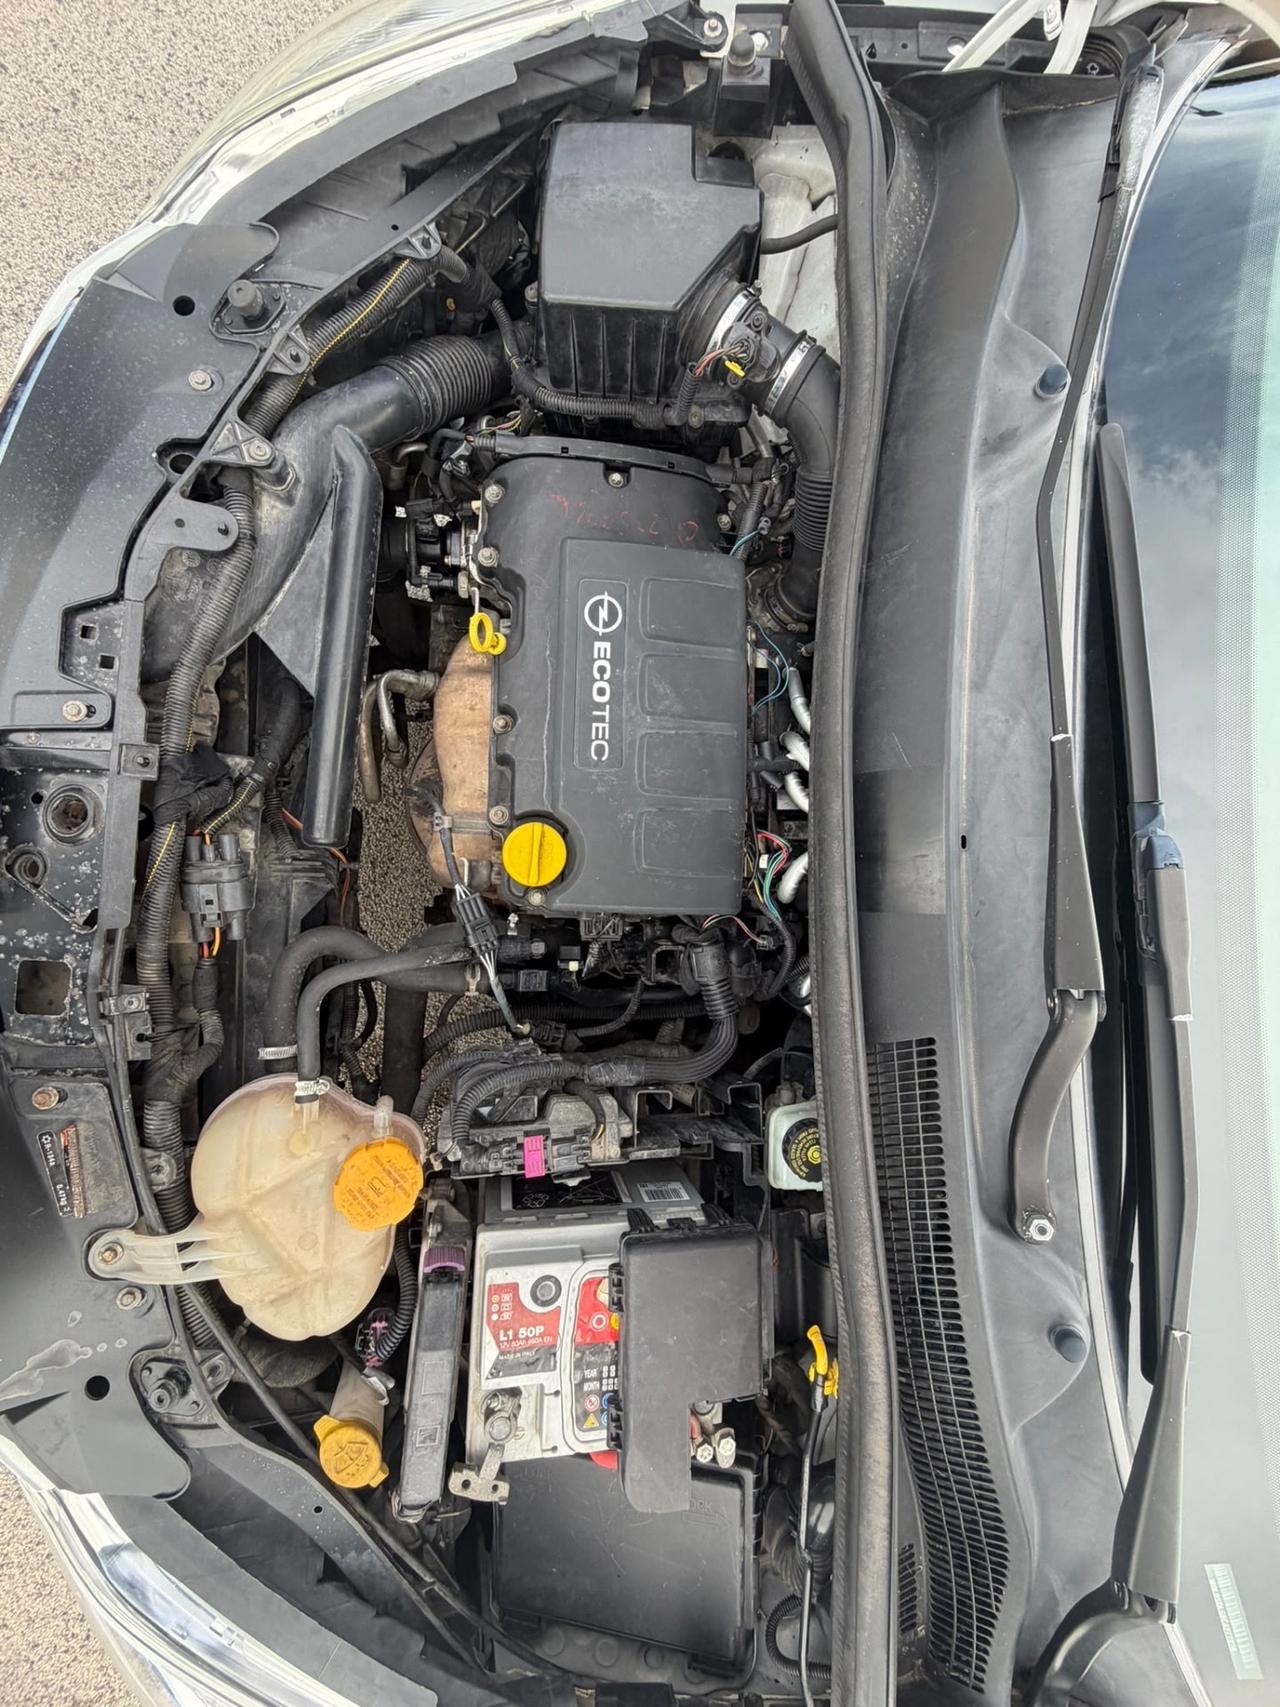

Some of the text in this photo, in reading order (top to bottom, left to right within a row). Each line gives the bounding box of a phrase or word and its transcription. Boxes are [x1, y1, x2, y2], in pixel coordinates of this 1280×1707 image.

[590, 641, 611, 761] ECOTEC
[499, 1326, 545, 1341] L1 50P
[584, 1368, 597, 1379] YEAR
[583, 1381, 600, 1391] MONTH
